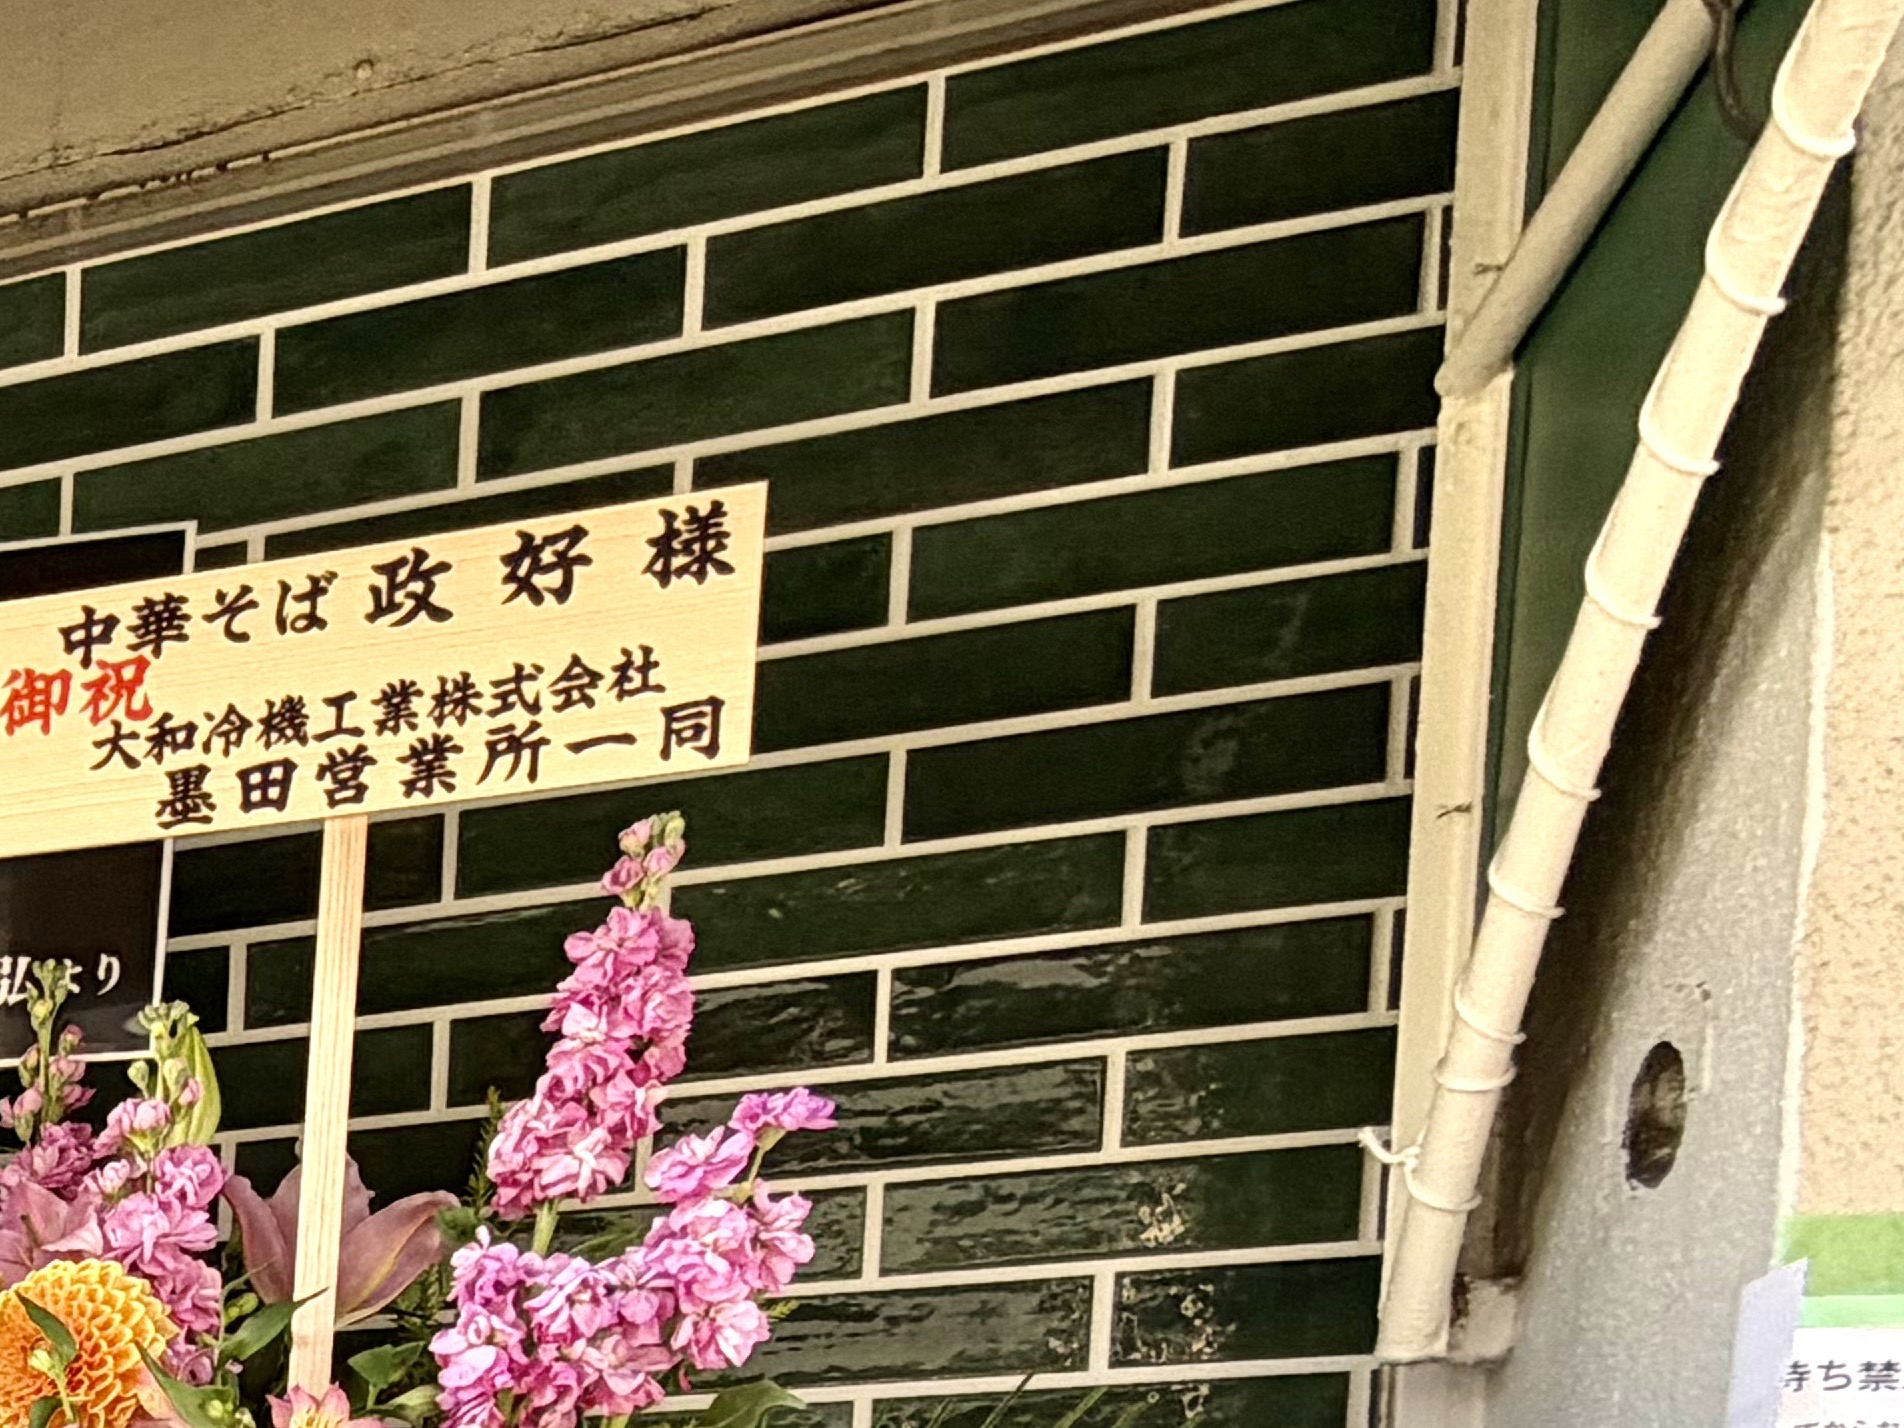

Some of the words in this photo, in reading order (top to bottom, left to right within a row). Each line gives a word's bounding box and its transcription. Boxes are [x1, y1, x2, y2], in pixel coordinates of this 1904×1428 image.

[89, 645, 667, 774] 大和冷機工業株式会社
[154, 696, 724, 829] 墨田営業所一同
